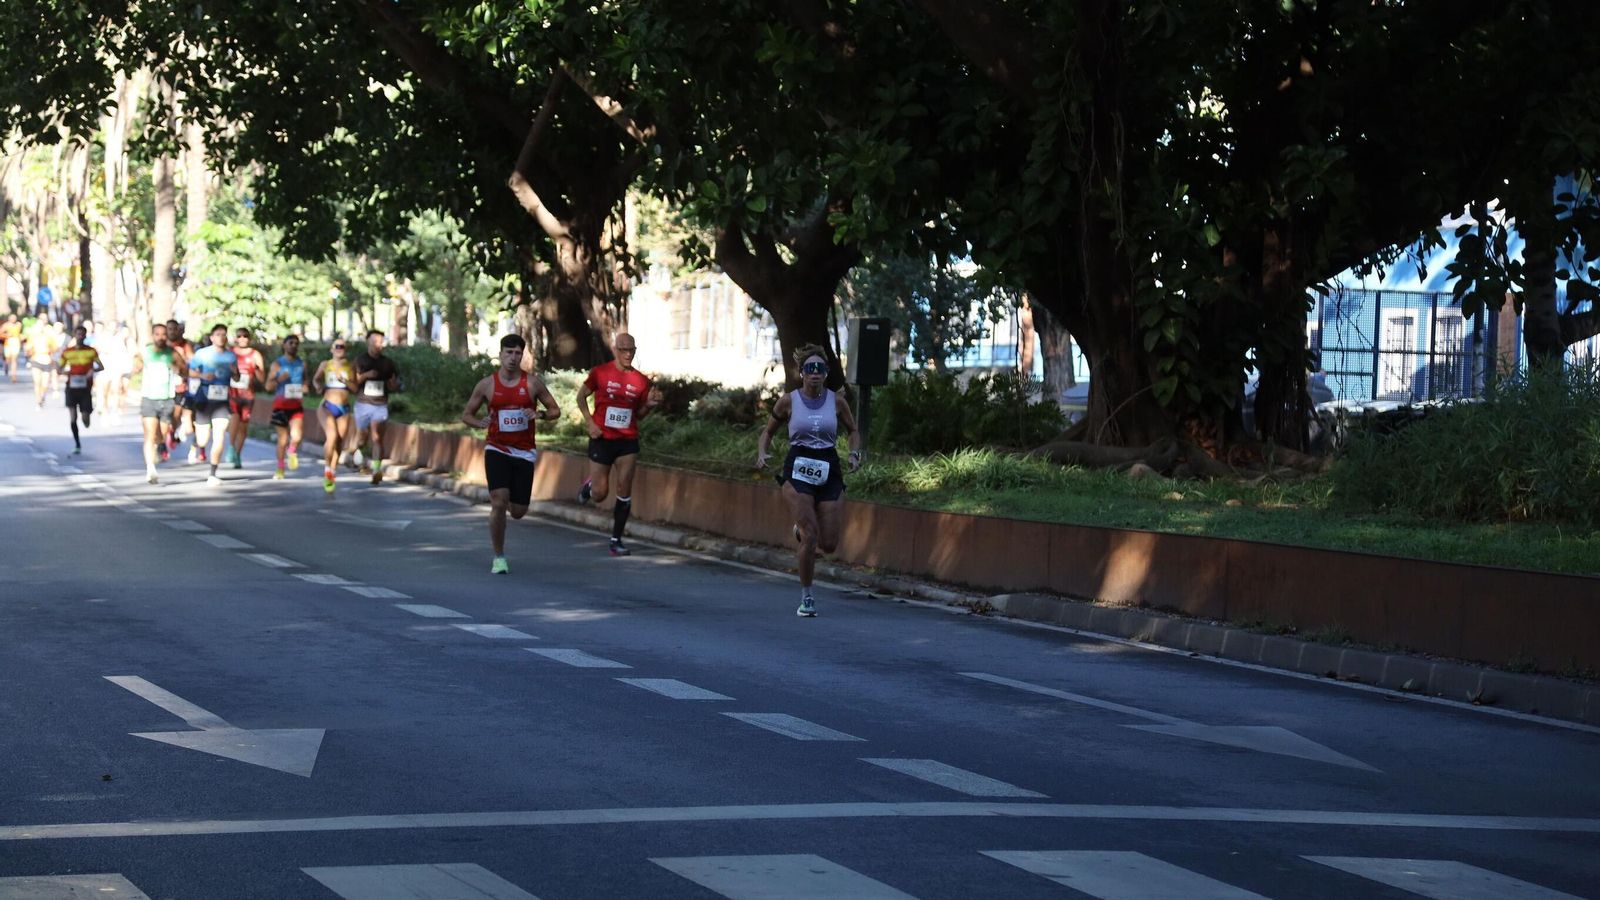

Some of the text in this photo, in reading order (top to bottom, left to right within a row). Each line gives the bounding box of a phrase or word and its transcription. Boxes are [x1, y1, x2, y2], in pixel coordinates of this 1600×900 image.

[503, 417, 524, 425] 609
[609, 413, 628, 423] 882
[798, 466, 822, 478] 464
